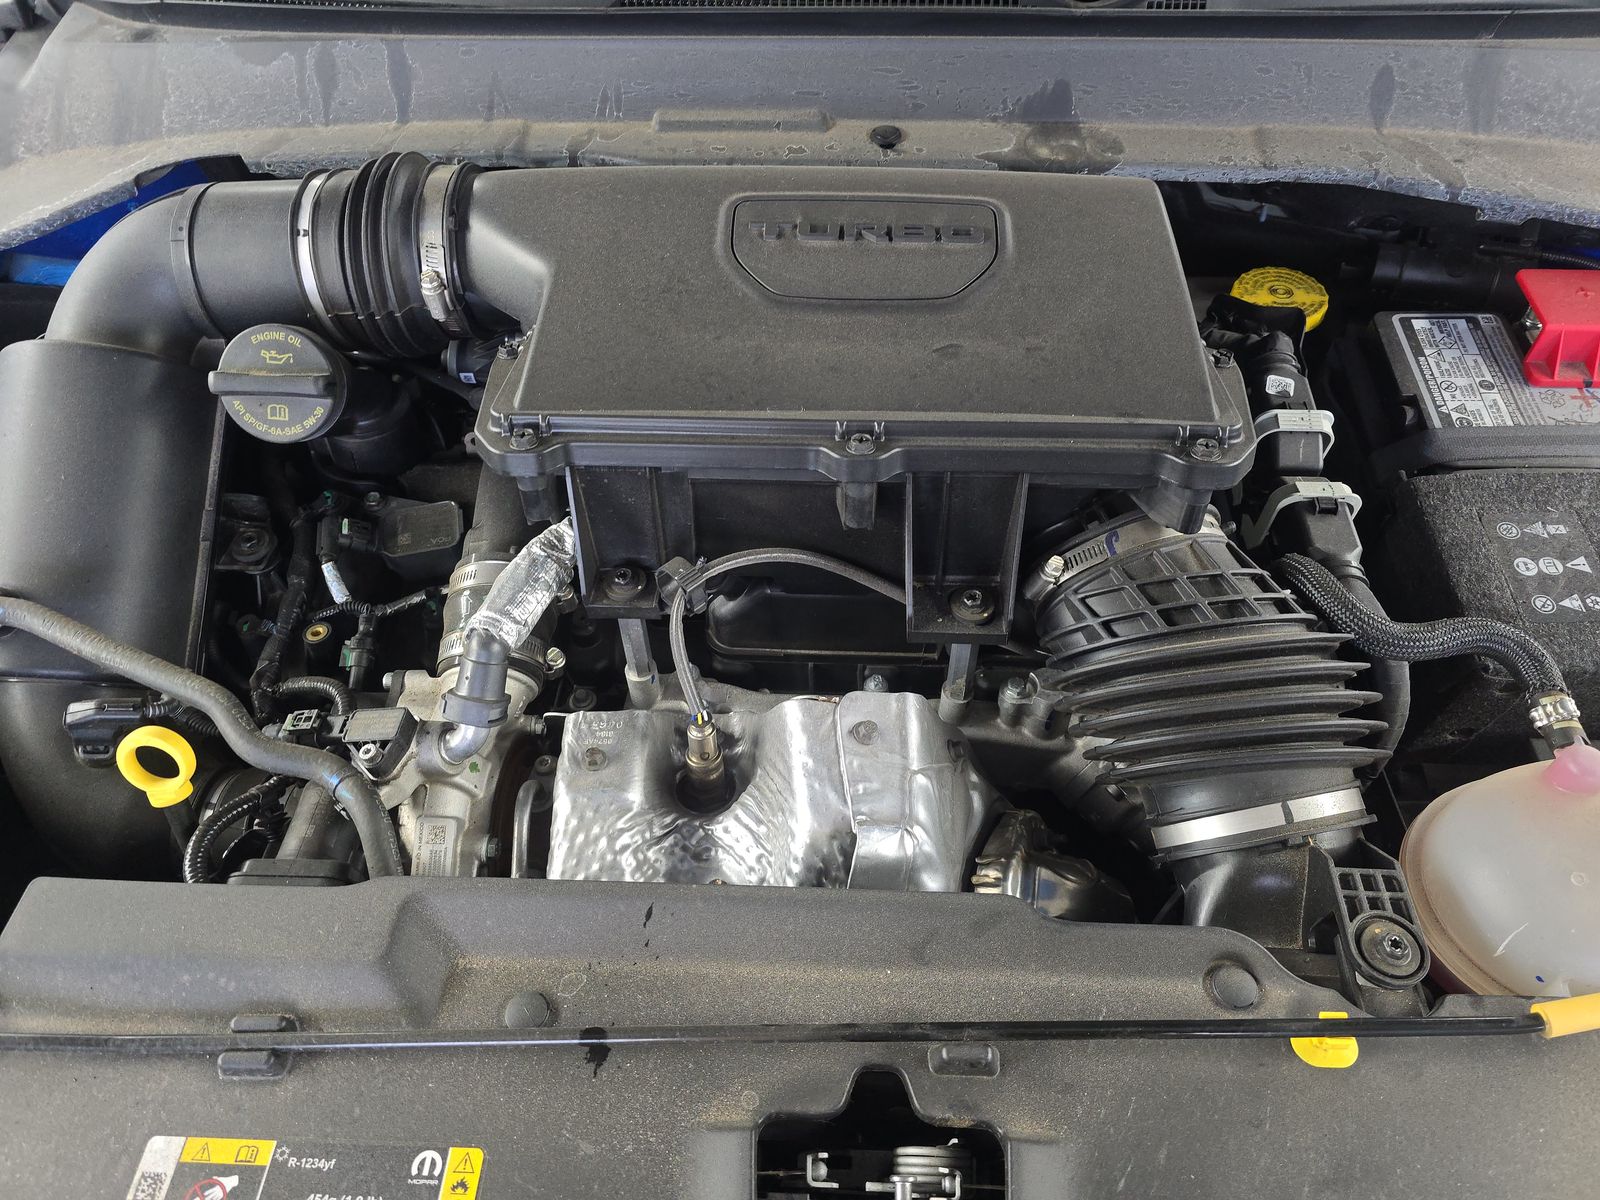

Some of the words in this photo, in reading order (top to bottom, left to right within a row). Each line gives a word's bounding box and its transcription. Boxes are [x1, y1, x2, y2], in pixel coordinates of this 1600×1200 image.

[250, 331, 286, 345] ENGINE
[287, 334, 302, 348] OIL
[1417, 356, 1445, 406] DANGER/POISON
[232, 399, 247, 415] API
[304, 406, 325, 430] 5W-30
[288, 1157, 336, 1171] R-1234yf
[408, 1178, 439, 1186] MOPAR
